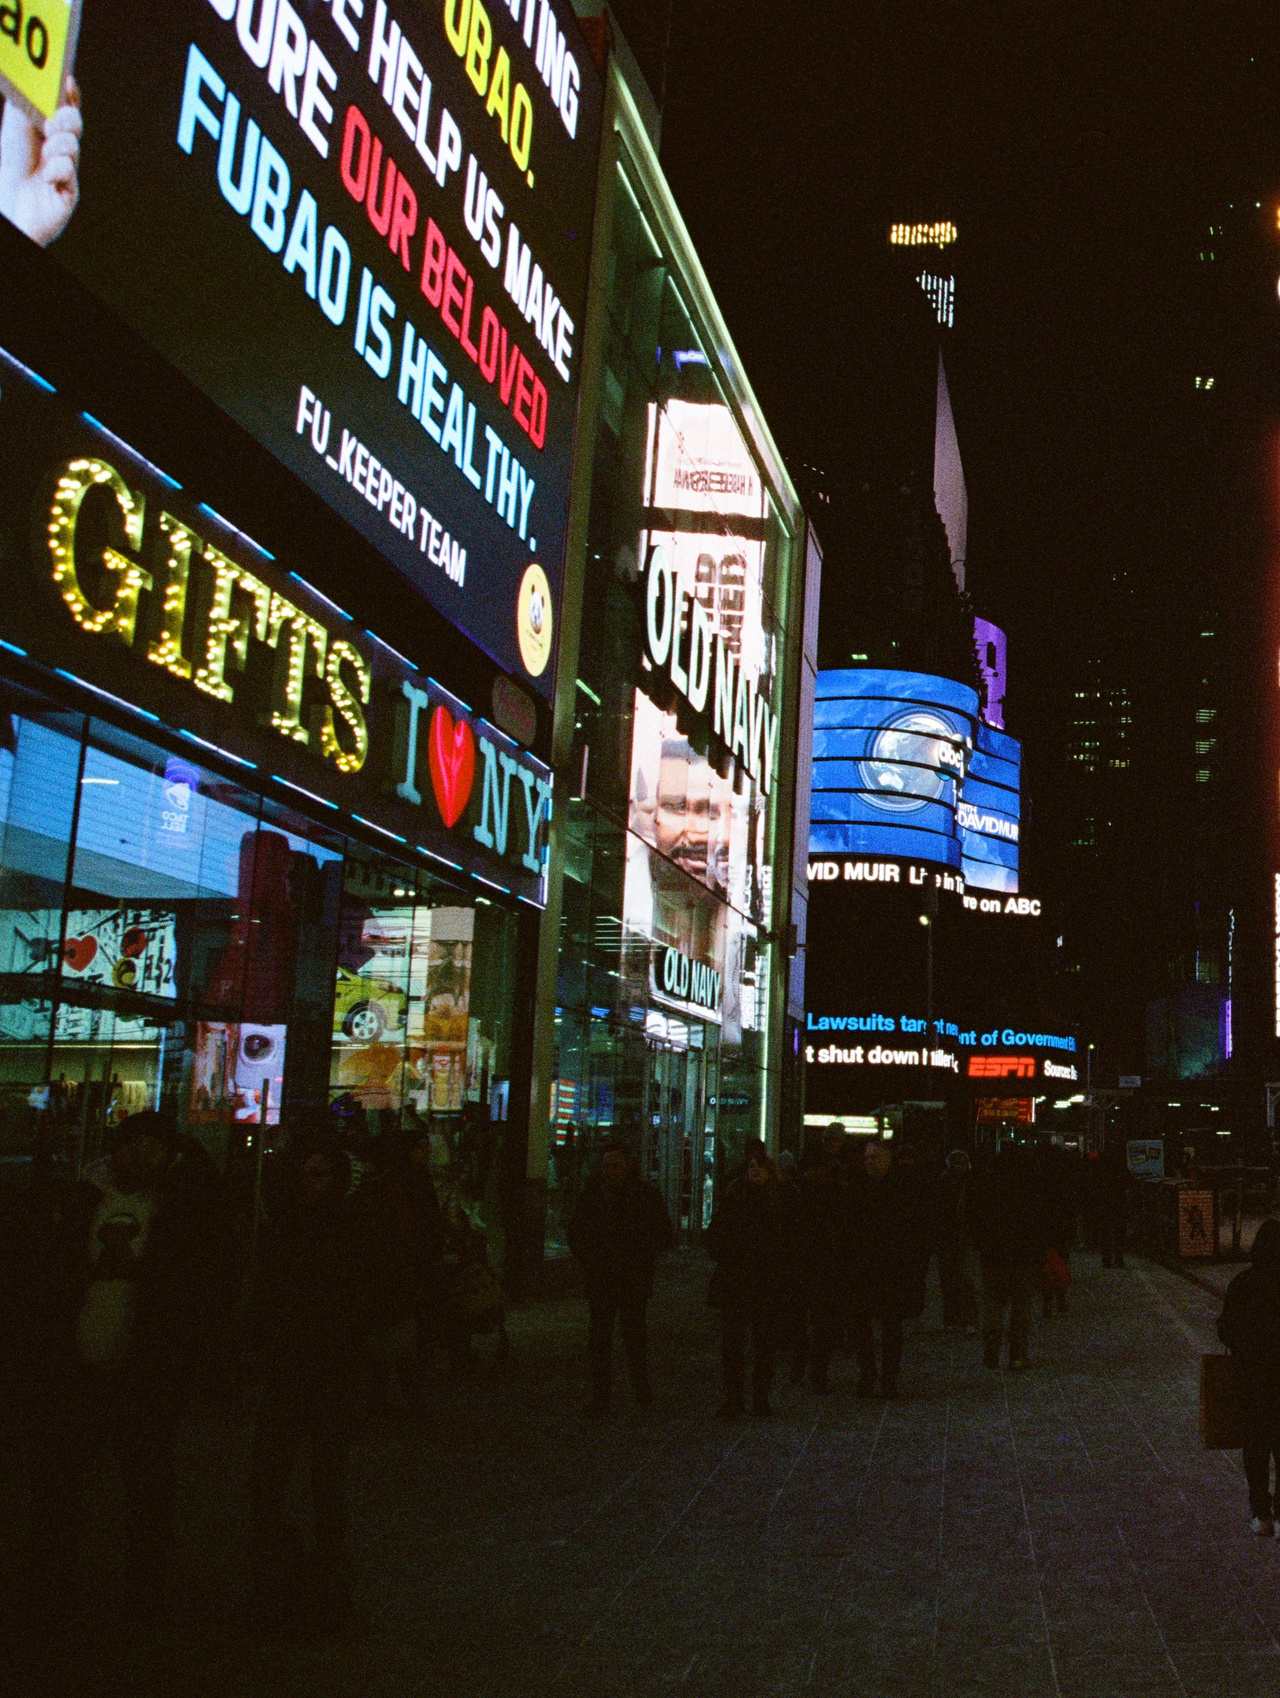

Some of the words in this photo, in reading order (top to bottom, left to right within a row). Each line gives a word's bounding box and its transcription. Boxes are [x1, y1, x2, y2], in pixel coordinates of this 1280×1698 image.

[208, 0, 338, 158] URE
[341, 104, 418, 272] OUR
[420, 217, 548, 449] BELOVED
[368, 0, 462, 187] HELP
[463, 153, 504, 268] US
[504, 223, 574, 383] MAKE
[177, 43, 350, 326] FUBAO
[354, 266, 396, 379] IS
[397, 321, 536, 552] HEALTHY.
[295, 384, 416, 540] FU_KEEPER
[419, 506, 467, 587] TEAM
[48, 457, 372, 774] GIFTS
[647, 544, 713, 714] OLD
[714, 632, 777, 797] NAVY
[397, 679, 429, 806] I
[474, 736, 552, 873] NY
[844, 862, 900, 882] MUIR
[980, 899, 1001, 912] on
[1004, 897, 1042, 916] ABC
[664, 946, 689, 998] OLD
[690, 959, 721, 1010] NAVY
[807, 1012, 895, 1031] Lawsuits
[900, 1015, 944, 1035] taret
[980, 1029, 999, 1045] of
[818, 1044, 865, 1064] shut
[868, 1045, 919, 1065] down
[968, 1056, 1035, 1077] ESPN
